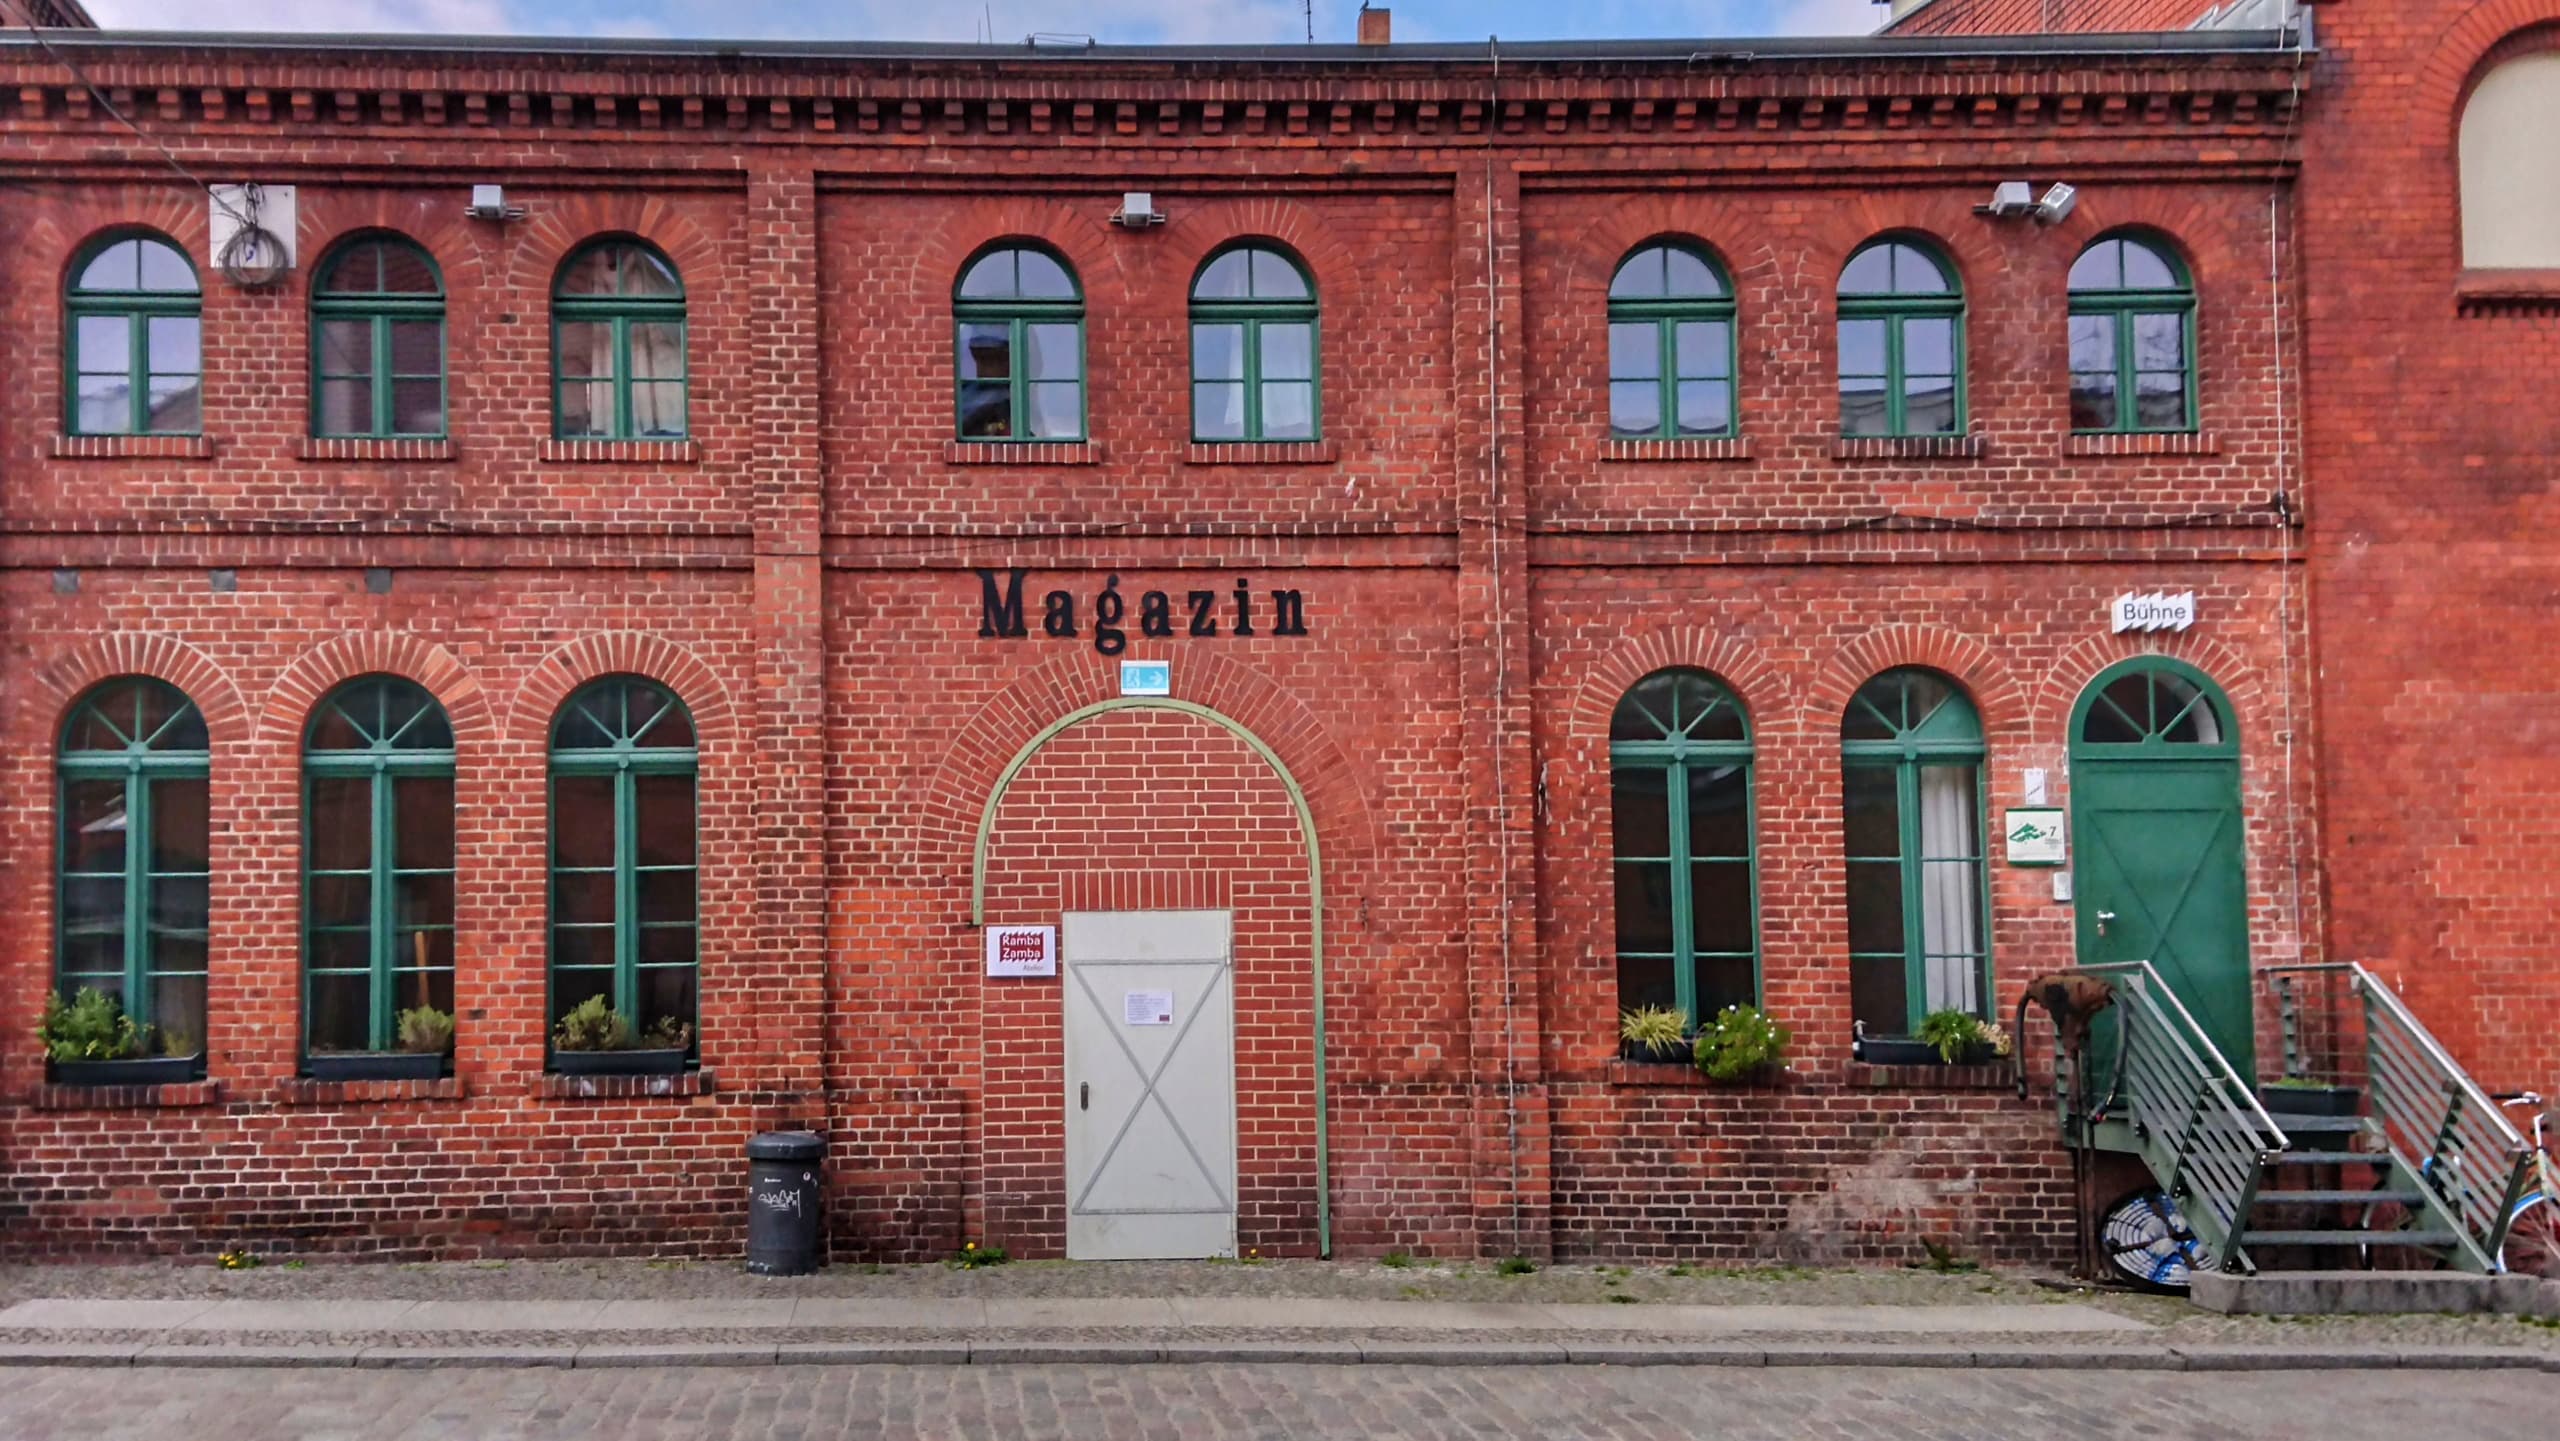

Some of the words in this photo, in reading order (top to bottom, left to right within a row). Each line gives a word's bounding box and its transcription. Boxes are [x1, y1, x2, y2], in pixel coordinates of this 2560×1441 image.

[975, 567, 1307, 656] Magazin
[2123, 603, 2187, 621] Bühne
[2049, 825, 2057, 837] 7
[1002, 934, 1041, 946] Ramba
[1002, 947, 1041, 959] Zamba
